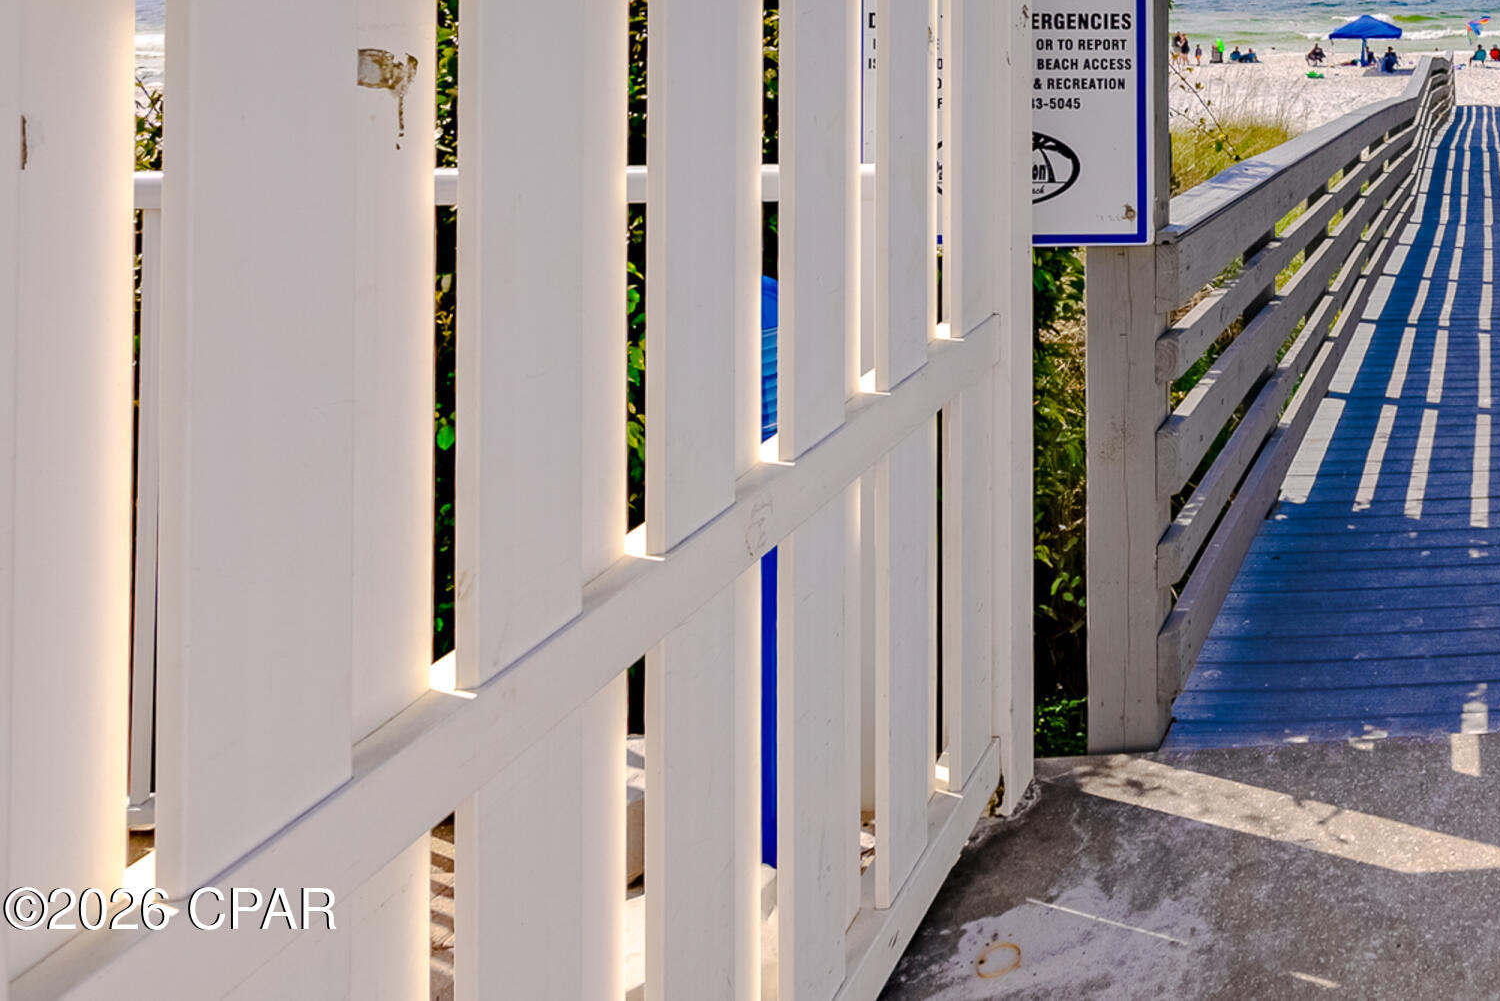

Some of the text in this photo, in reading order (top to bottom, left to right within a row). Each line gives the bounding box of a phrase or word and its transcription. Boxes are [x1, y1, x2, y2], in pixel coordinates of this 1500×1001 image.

[1031, 13, 1132, 30] ERGENCIES
[1036, 38, 1127, 51] OR TO REPORT
[1037, 58, 1131, 70] BEACH ACCESS
[1033, 77, 1125, 90] & RECREATION
[1031, 98, 1081, 110] 3-5045
